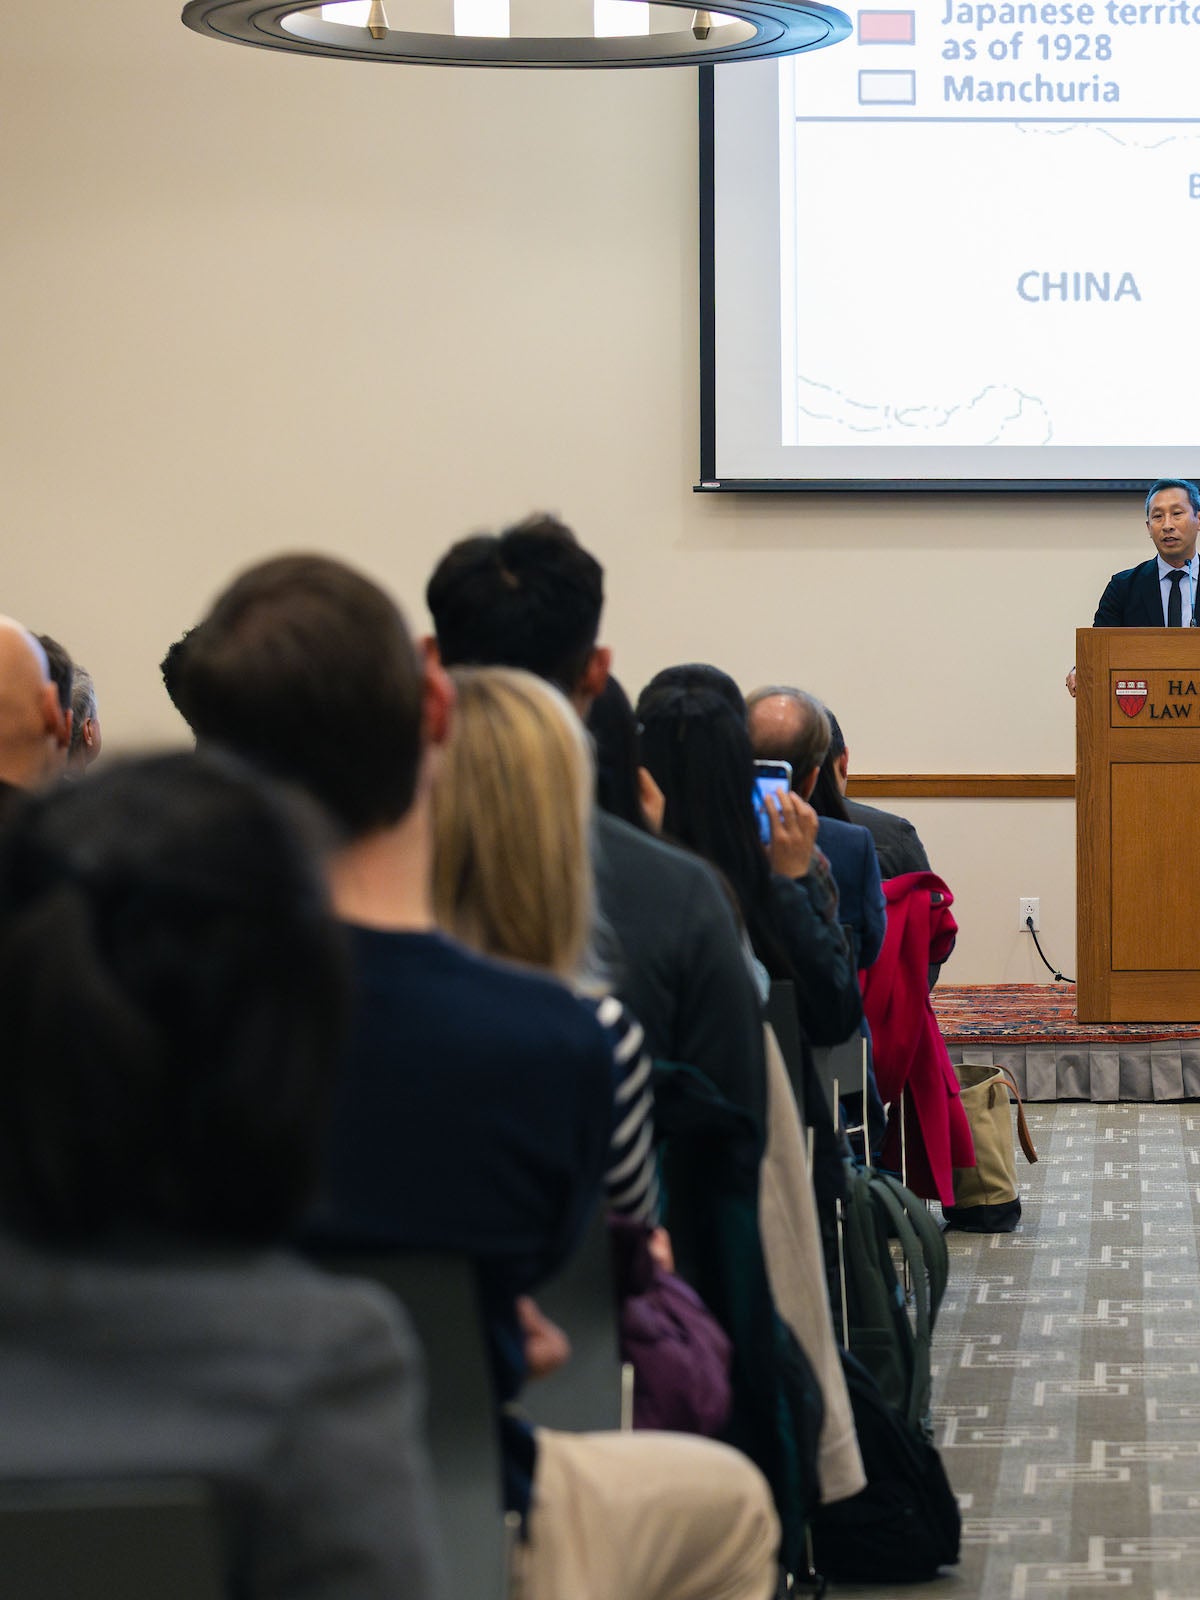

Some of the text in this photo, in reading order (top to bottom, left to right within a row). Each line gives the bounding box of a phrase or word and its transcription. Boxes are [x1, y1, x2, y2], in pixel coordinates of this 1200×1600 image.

[941, 0, 1095, 31] Japanese
[941, 31, 1112, 61] as of 1928
[943, 73, 1120, 103] Manchuria
[1017, 270, 1142, 303] CHINA
[1150, 704, 1193, 719] LAW
